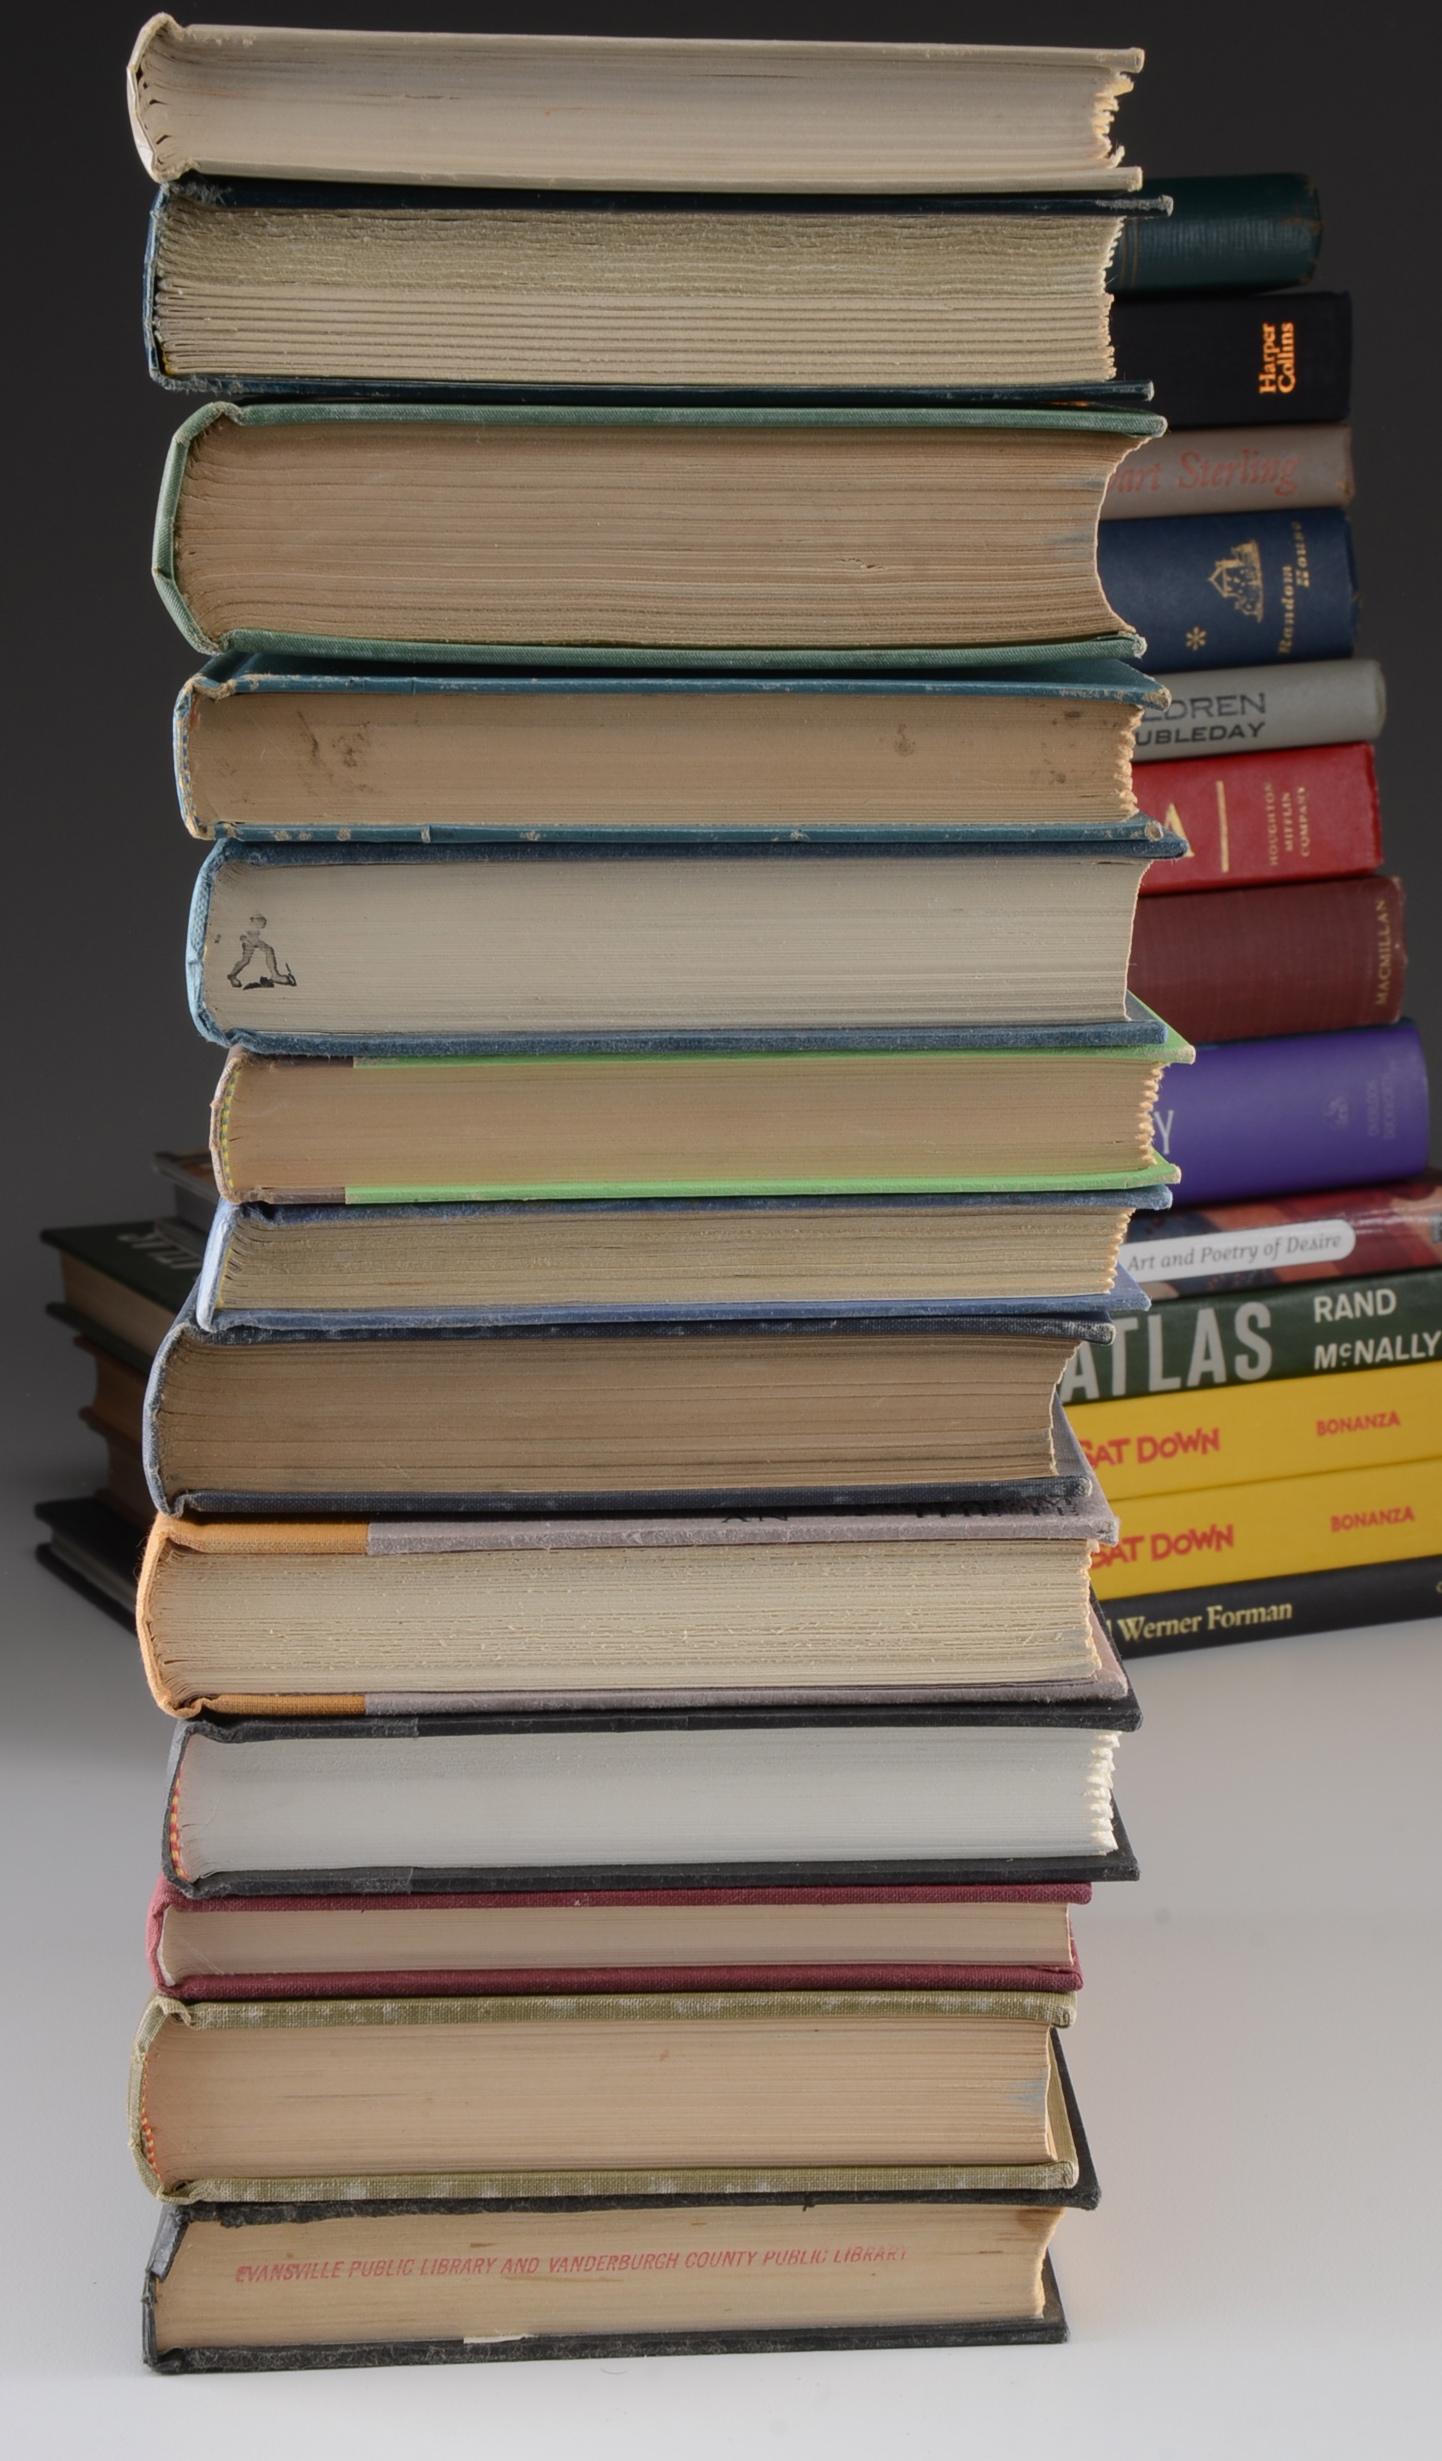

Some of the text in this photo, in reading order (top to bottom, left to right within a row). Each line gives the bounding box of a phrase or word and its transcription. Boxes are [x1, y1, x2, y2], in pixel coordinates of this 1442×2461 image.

[1259, 322, 1280, 394] Harper
[1277, 322, 1296, 393] Collins
[1177, 447, 1301, 497] Sterling
[1376, 899, 1391, 1005] MACMILLAN
[1127, 1232, 1342, 1272] Art and Poetry of Desire
[1314, 1288, 1397, 1323] RAND
[1060, 1301, 1273, 1404] ATLAS
[1316, 1411, 1401, 1437] BONANZA
[1136, 1427, 1220, 1464] DOWN
[1330, 1505, 1415, 1533] BONANZA
[1150, 1523, 1234, 1562] DOWN
[1117, 1616, 1203, 1643] Werner
[1206, 1603, 1293, 1631] Forman
[235, 2260, 345, 2283] EVANSVILLE
[348, 2258, 415, 2279] PUBLIC
[420, 2256, 498, 2276] LIBRARY
[500, 2256, 540, 2275] AND
[548, 2252, 680, 2273] VANDERBURGH
[684, 2250, 757, 2269] COUNTY
[762, 2248, 828, 2267] PUBLIC
